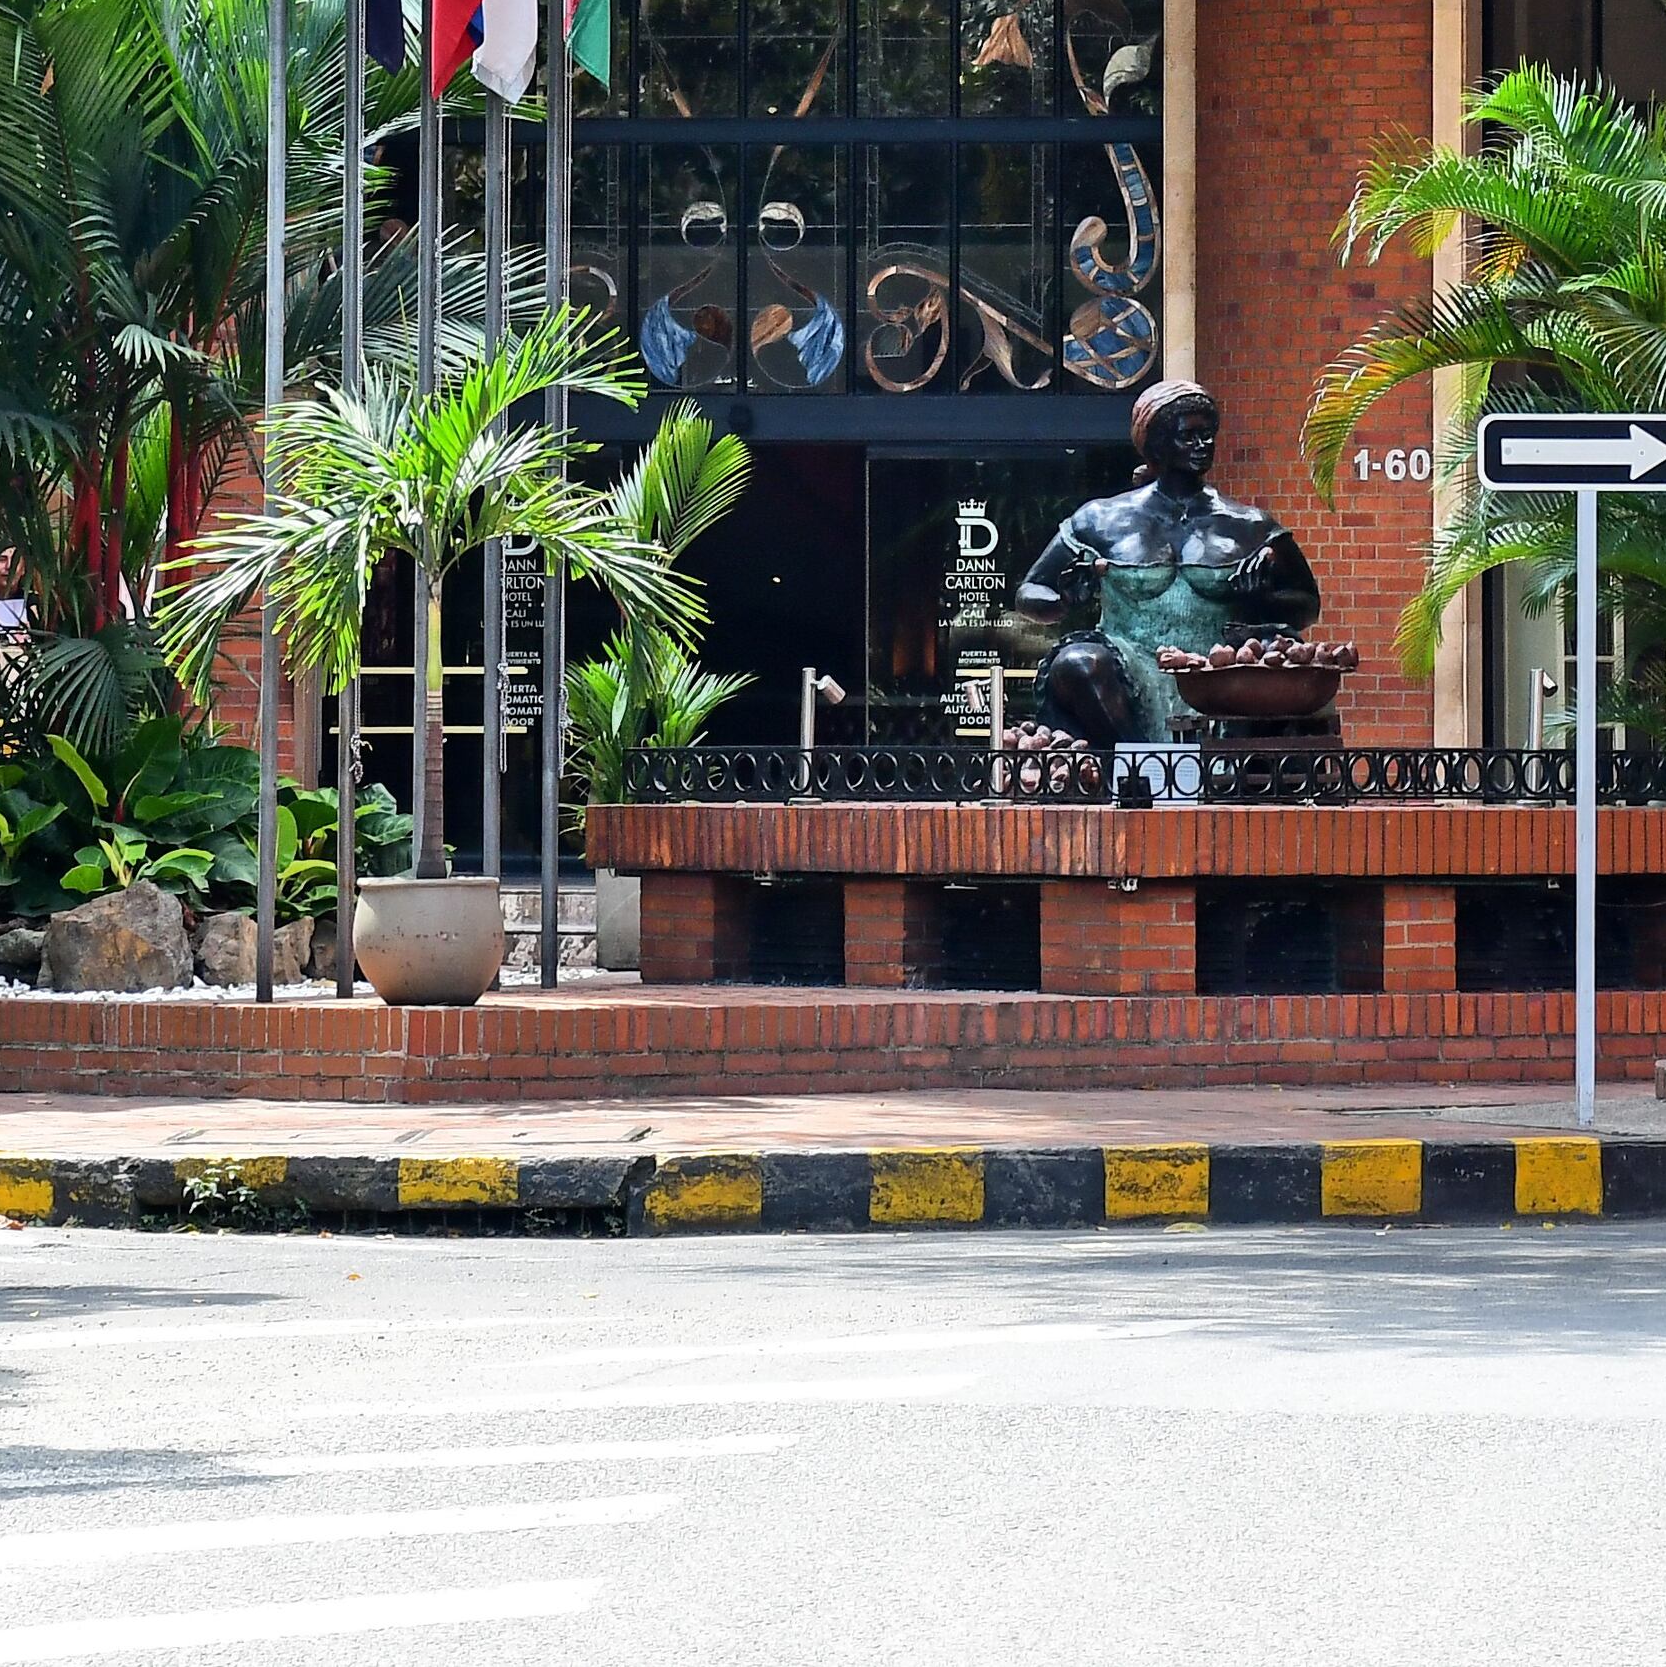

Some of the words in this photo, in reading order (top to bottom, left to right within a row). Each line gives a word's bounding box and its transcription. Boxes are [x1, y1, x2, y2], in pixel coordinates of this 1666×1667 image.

[1353, 448, 1431, 482] 1-60
[501, 558, 537, 572] ANN
[956, 558, 995, 572] DANN
[945, 576, 1006, 590] CARLTON
[959, 592, 991, 602] HOTEL
[962, 609, 985, 619] CALI
[521, 620, 533, 628] UN
[938, 619, 949, 627] LA
[969, 619, 978, 627] ES
[979, 619, 992, 627] UN
[993, 619, 1013, 627] LUJO
[507, 684, 537, 693] UERTA
[959, 716, 991, 725] DOOR
